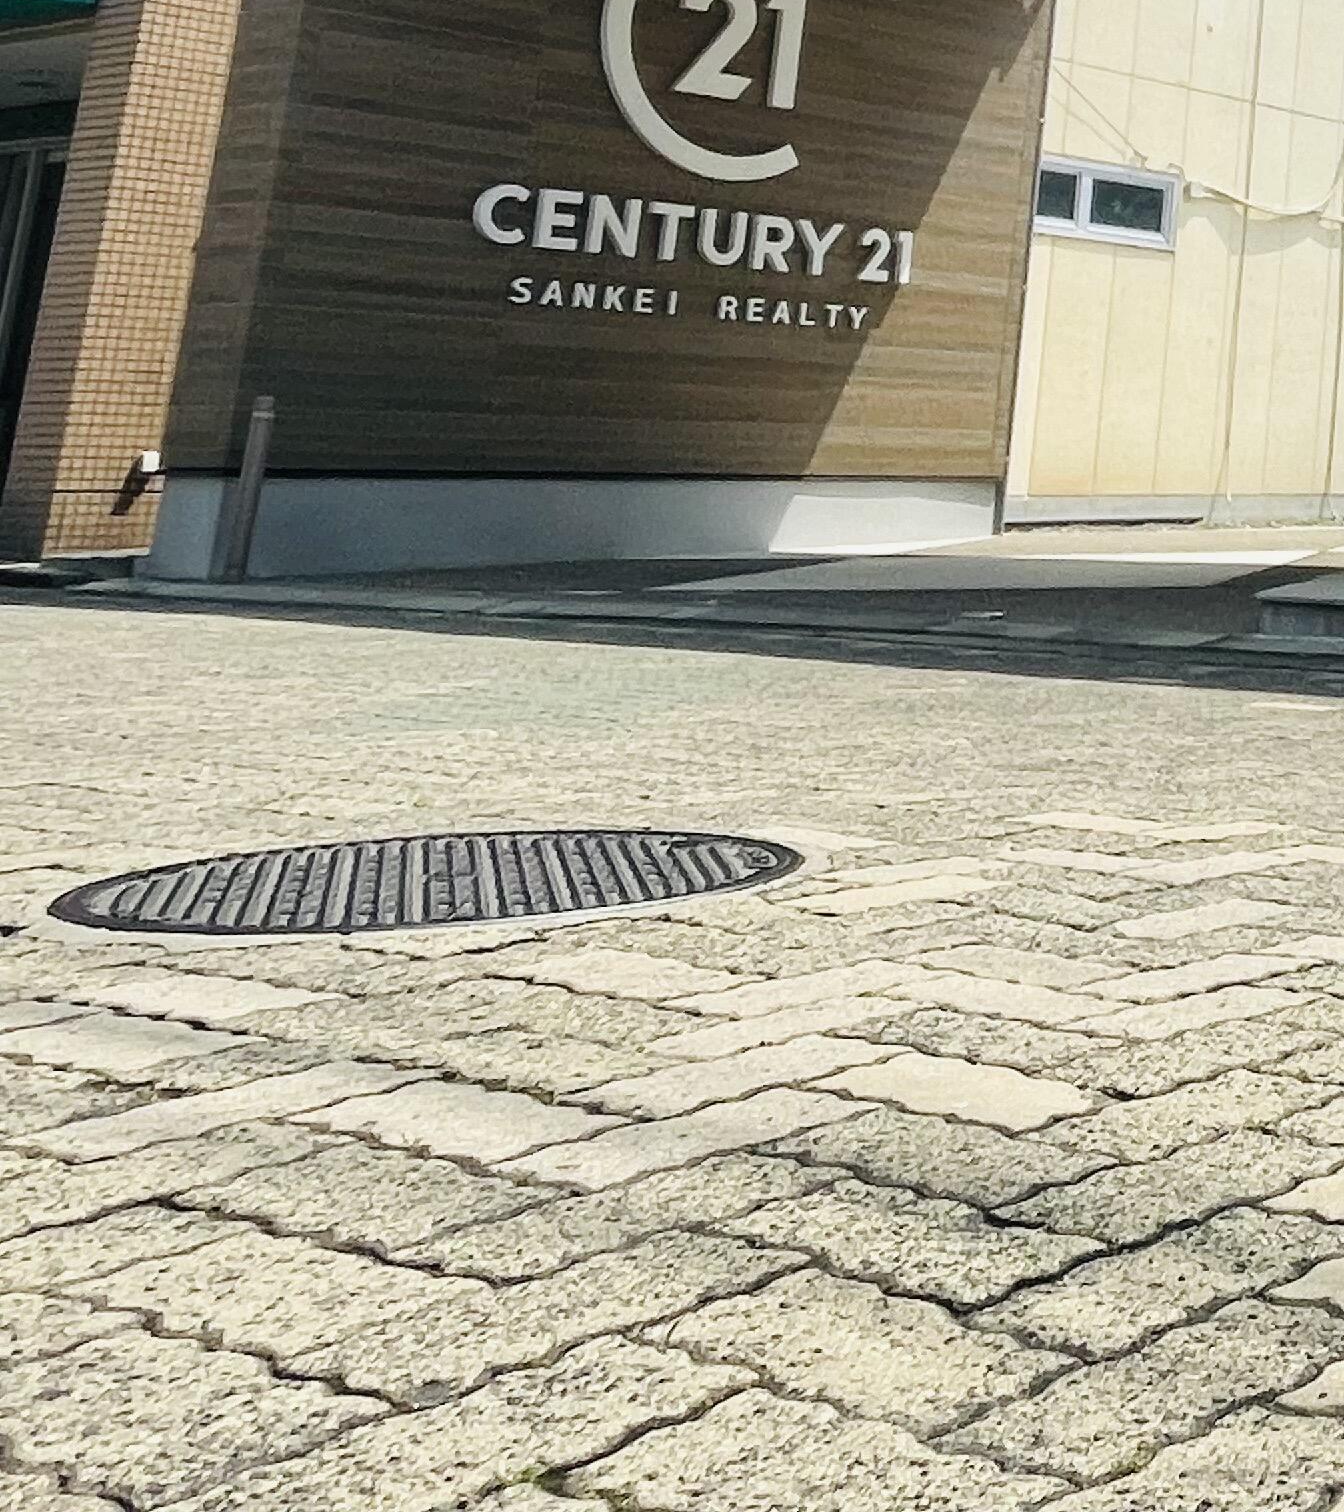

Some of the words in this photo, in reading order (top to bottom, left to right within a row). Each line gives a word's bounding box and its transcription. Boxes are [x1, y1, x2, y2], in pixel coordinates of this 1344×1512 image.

[472, 183, 844, 277] CENTURY
[857, 228, 915, 284] 21
[507, 276, 679, 317] SANKEI
[717, 294, 871, 330] REALTY
